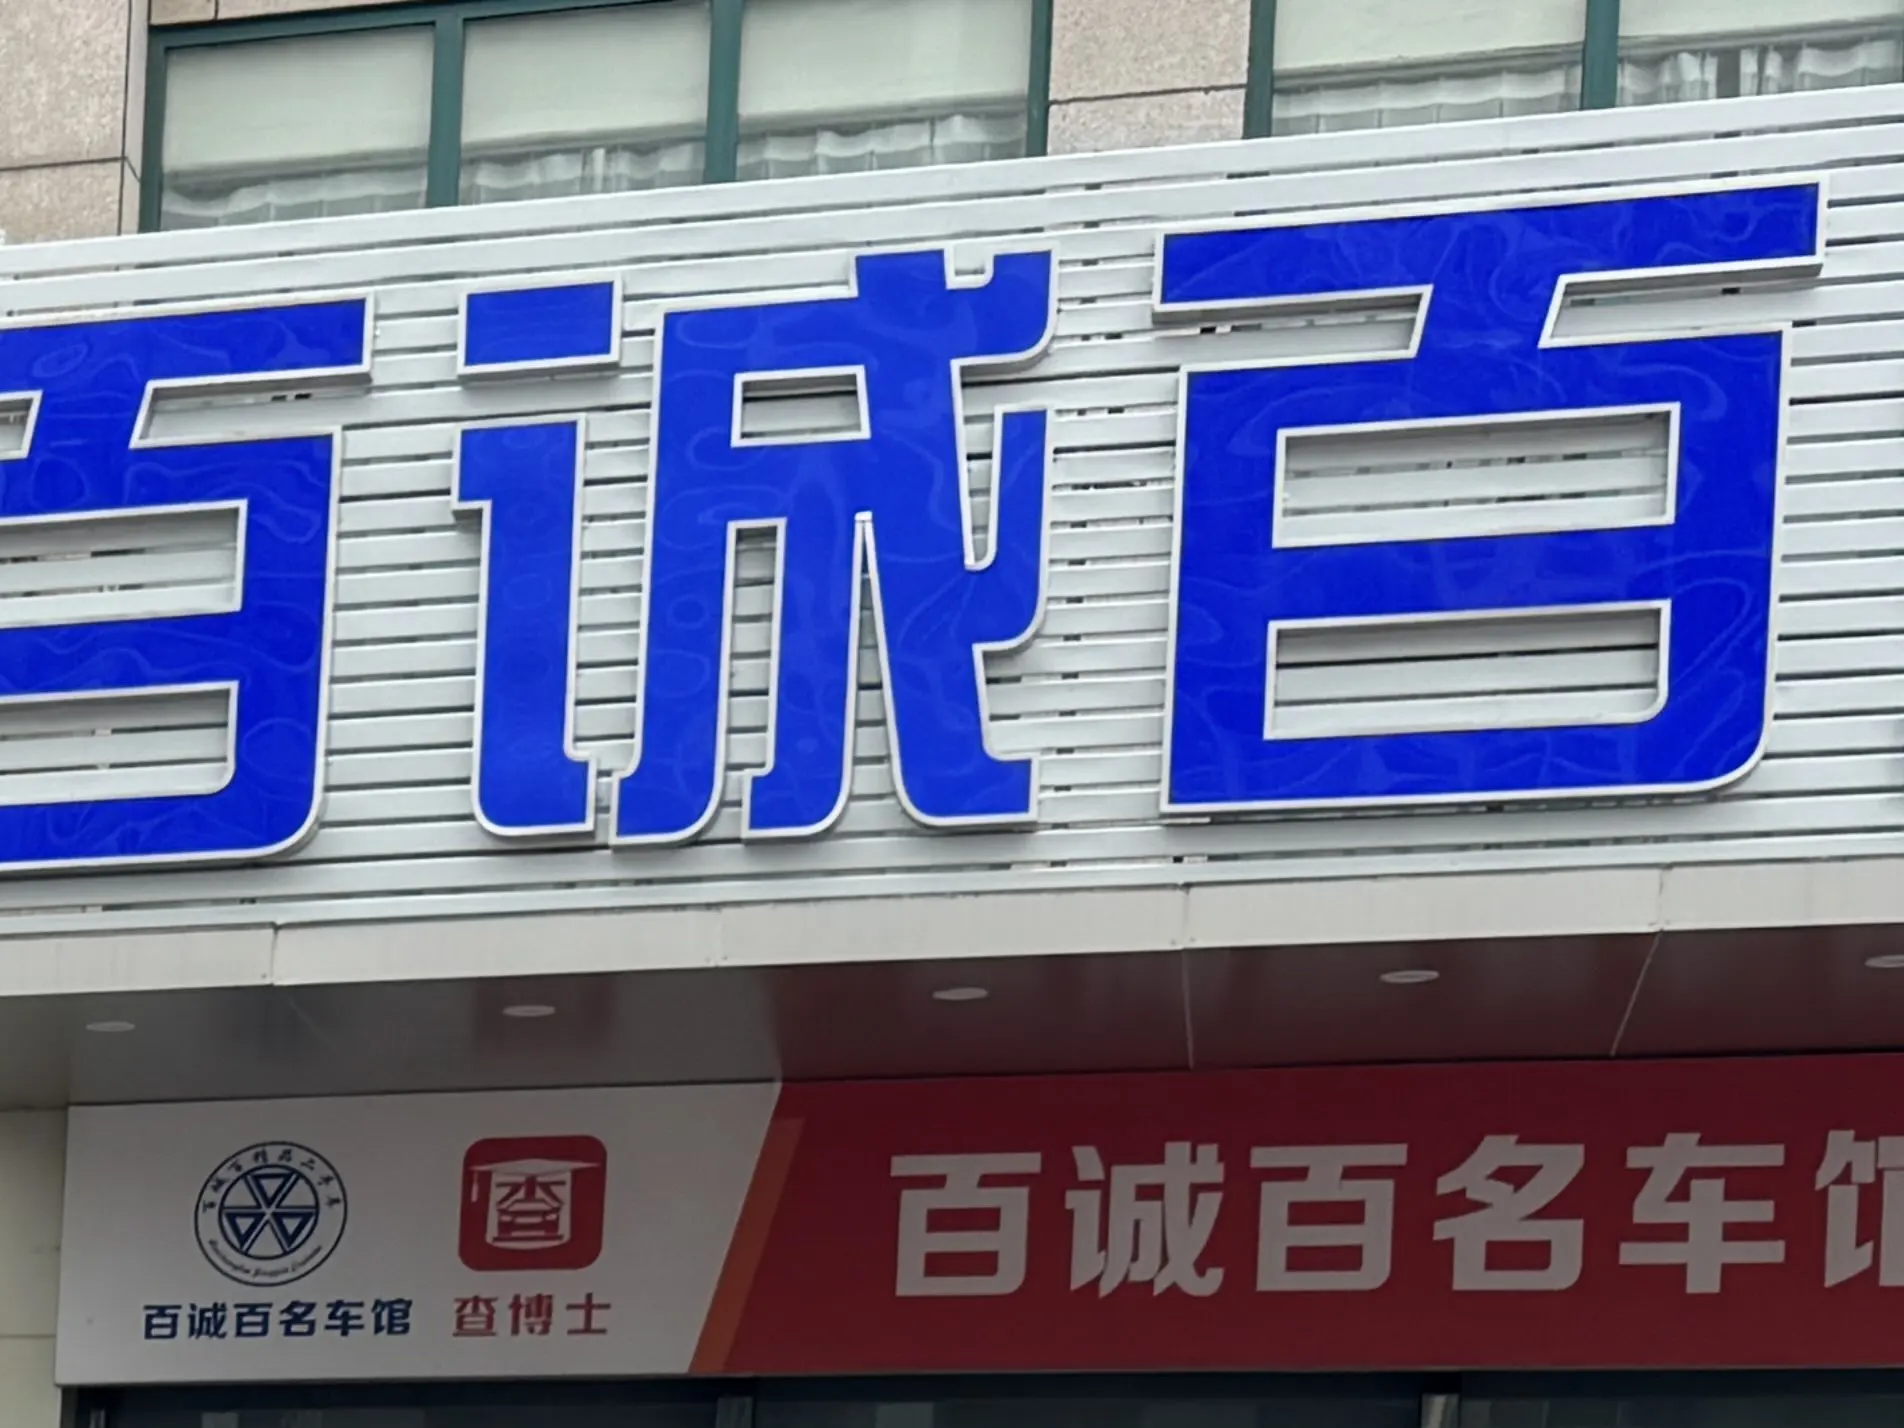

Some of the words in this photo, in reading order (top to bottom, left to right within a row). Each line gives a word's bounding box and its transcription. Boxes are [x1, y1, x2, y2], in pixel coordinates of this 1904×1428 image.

[141, 1299, 413, 1341] 百诚百名车馆
[451, 1294, 613, 1339] 查博士
